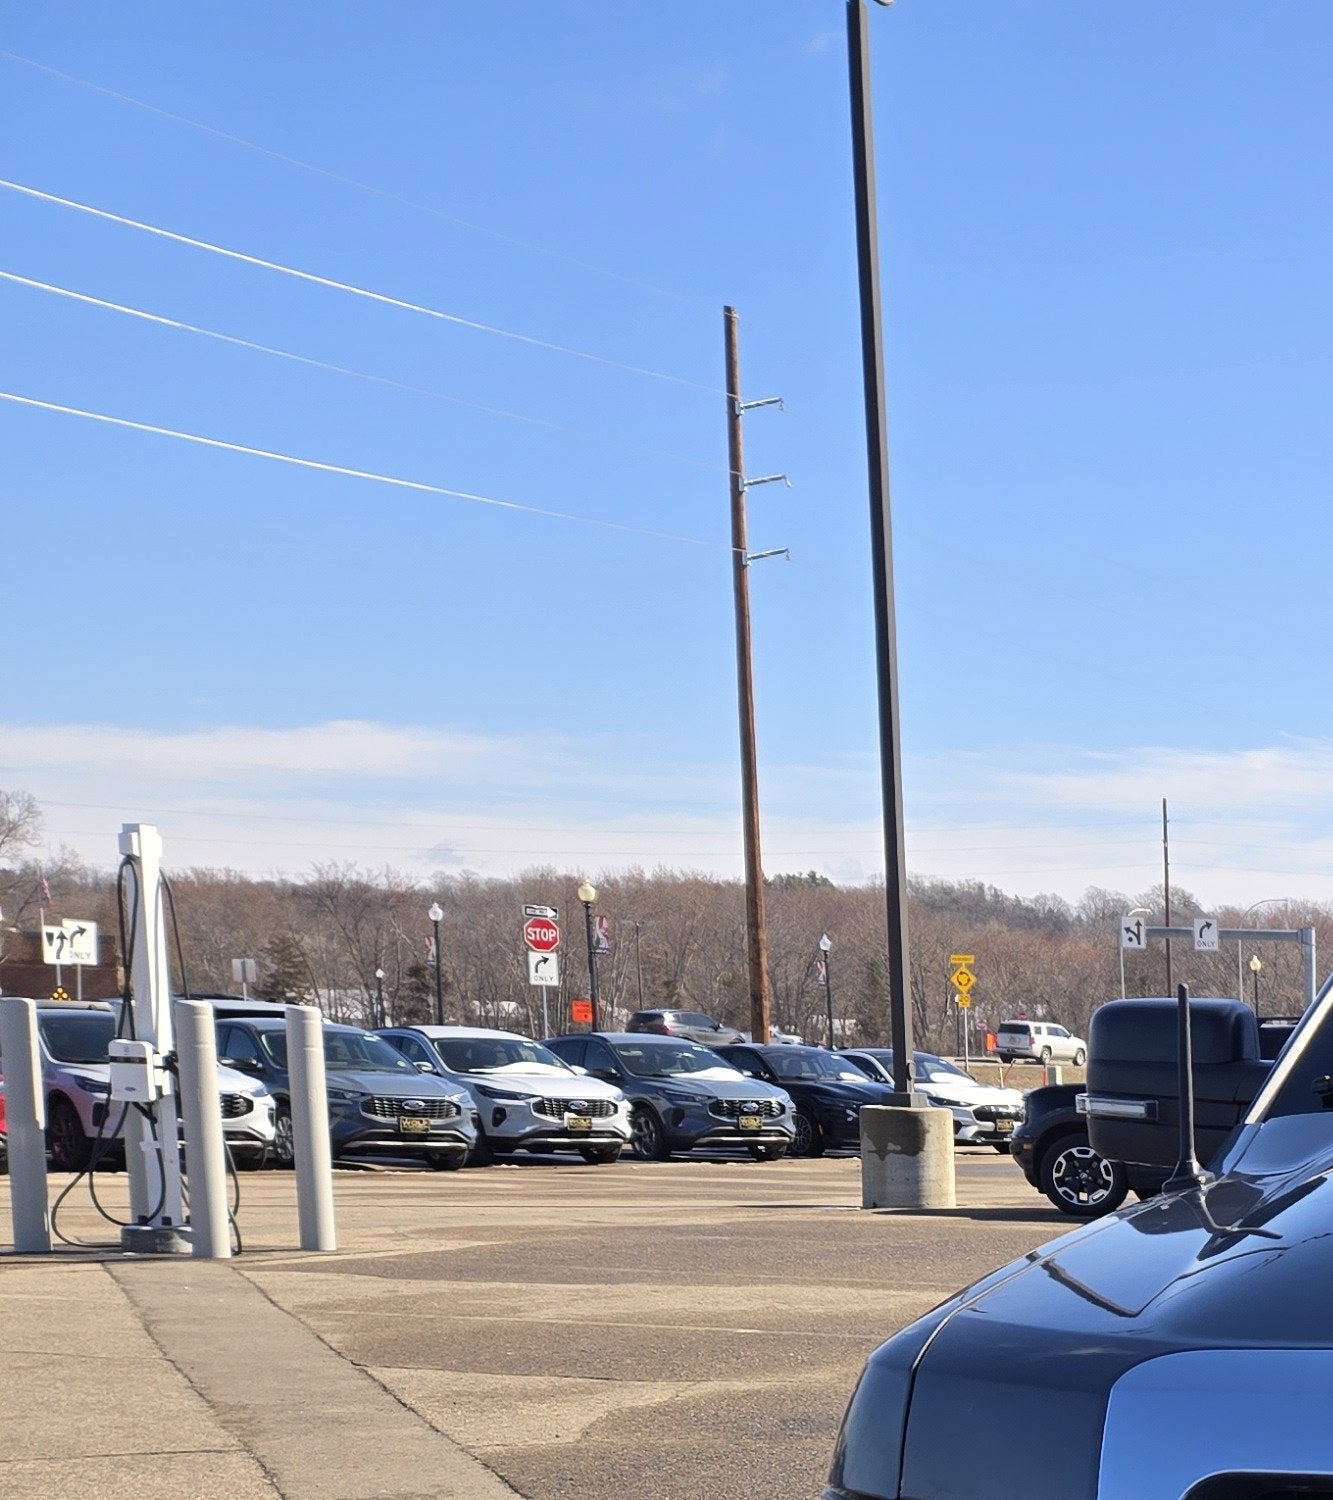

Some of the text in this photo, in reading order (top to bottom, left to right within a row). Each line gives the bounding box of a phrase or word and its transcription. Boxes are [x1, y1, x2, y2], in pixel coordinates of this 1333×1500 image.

[527, 927, 557, 942] STOP
[1196, 940, 1215, 948] ONLY
[533, 974, 554, 982] ONLY
